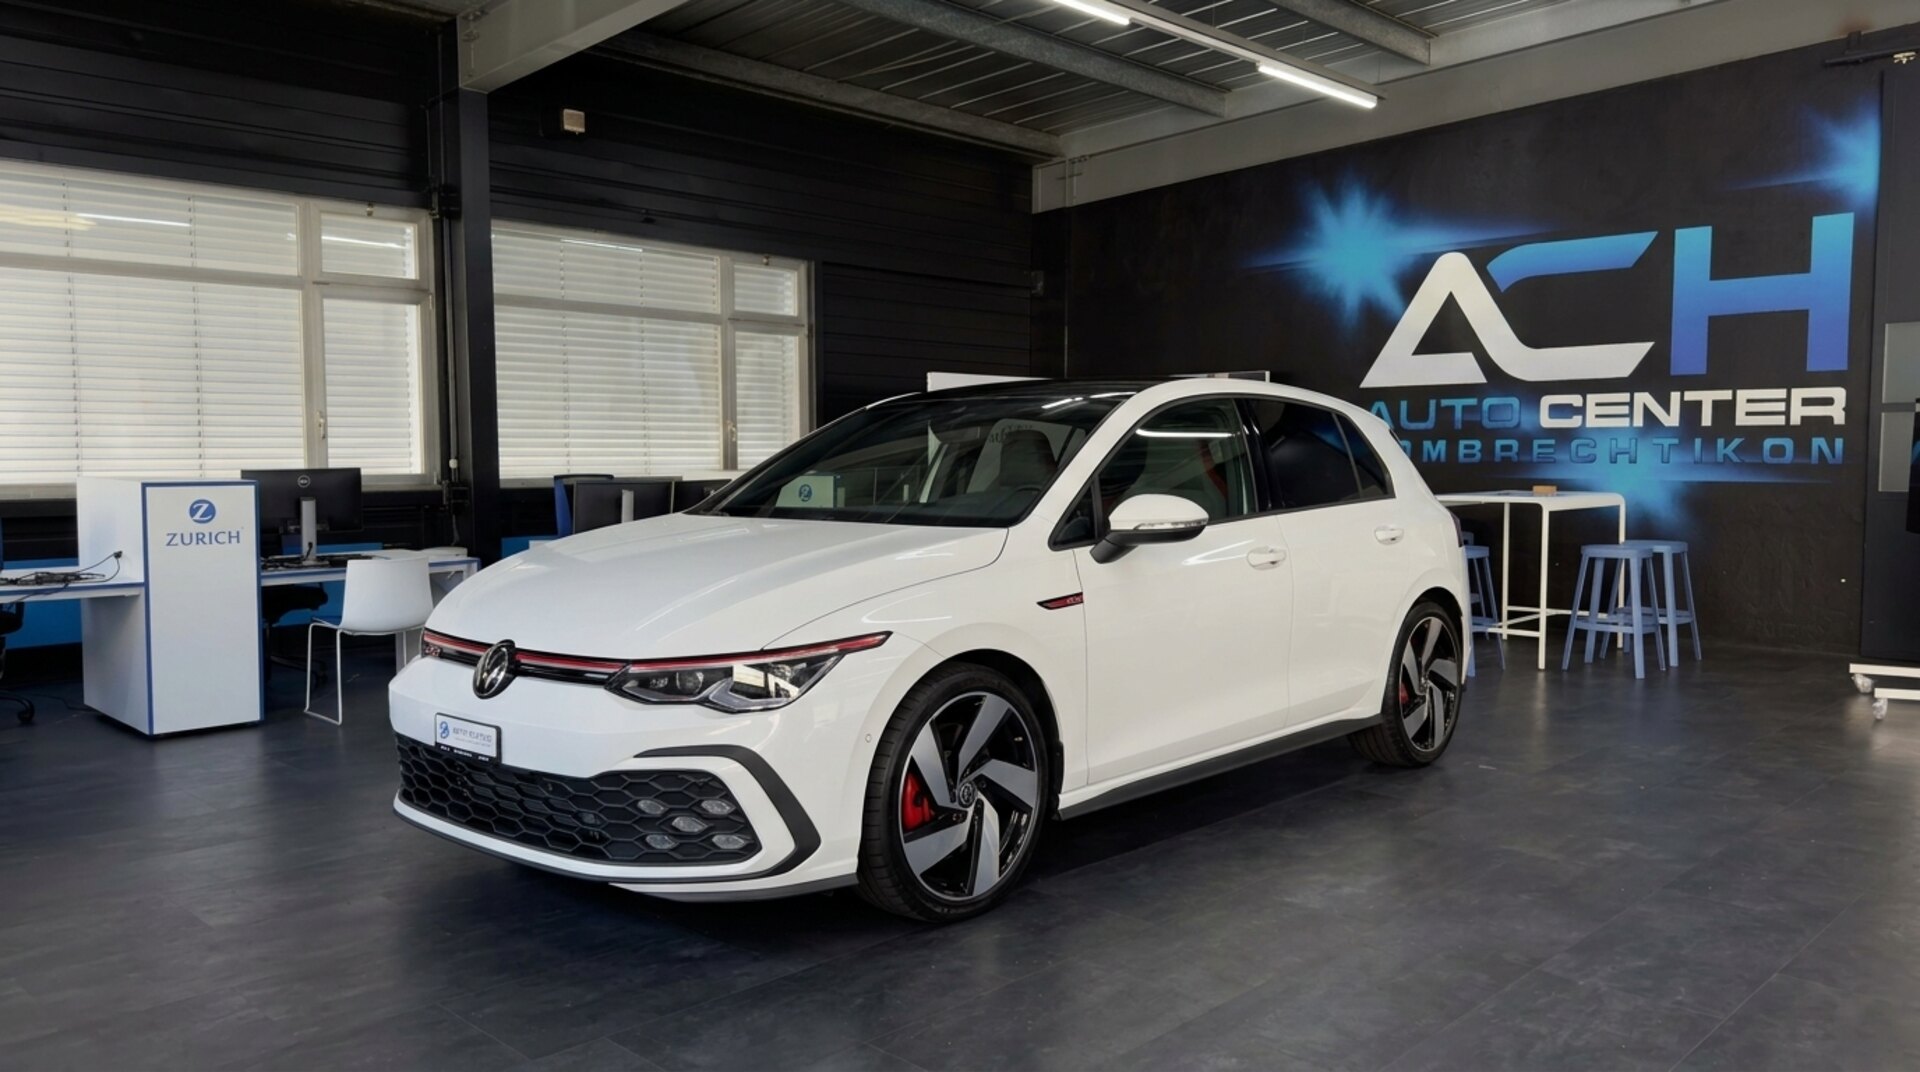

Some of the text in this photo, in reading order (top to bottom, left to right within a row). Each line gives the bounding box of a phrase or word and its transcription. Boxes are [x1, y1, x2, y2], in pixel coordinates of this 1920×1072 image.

[1359, 212, 1855, 388] ACH
[1370, 386, 1847, 430] AUTO CENTER
[165, 530, 241, 547] ZURICH
